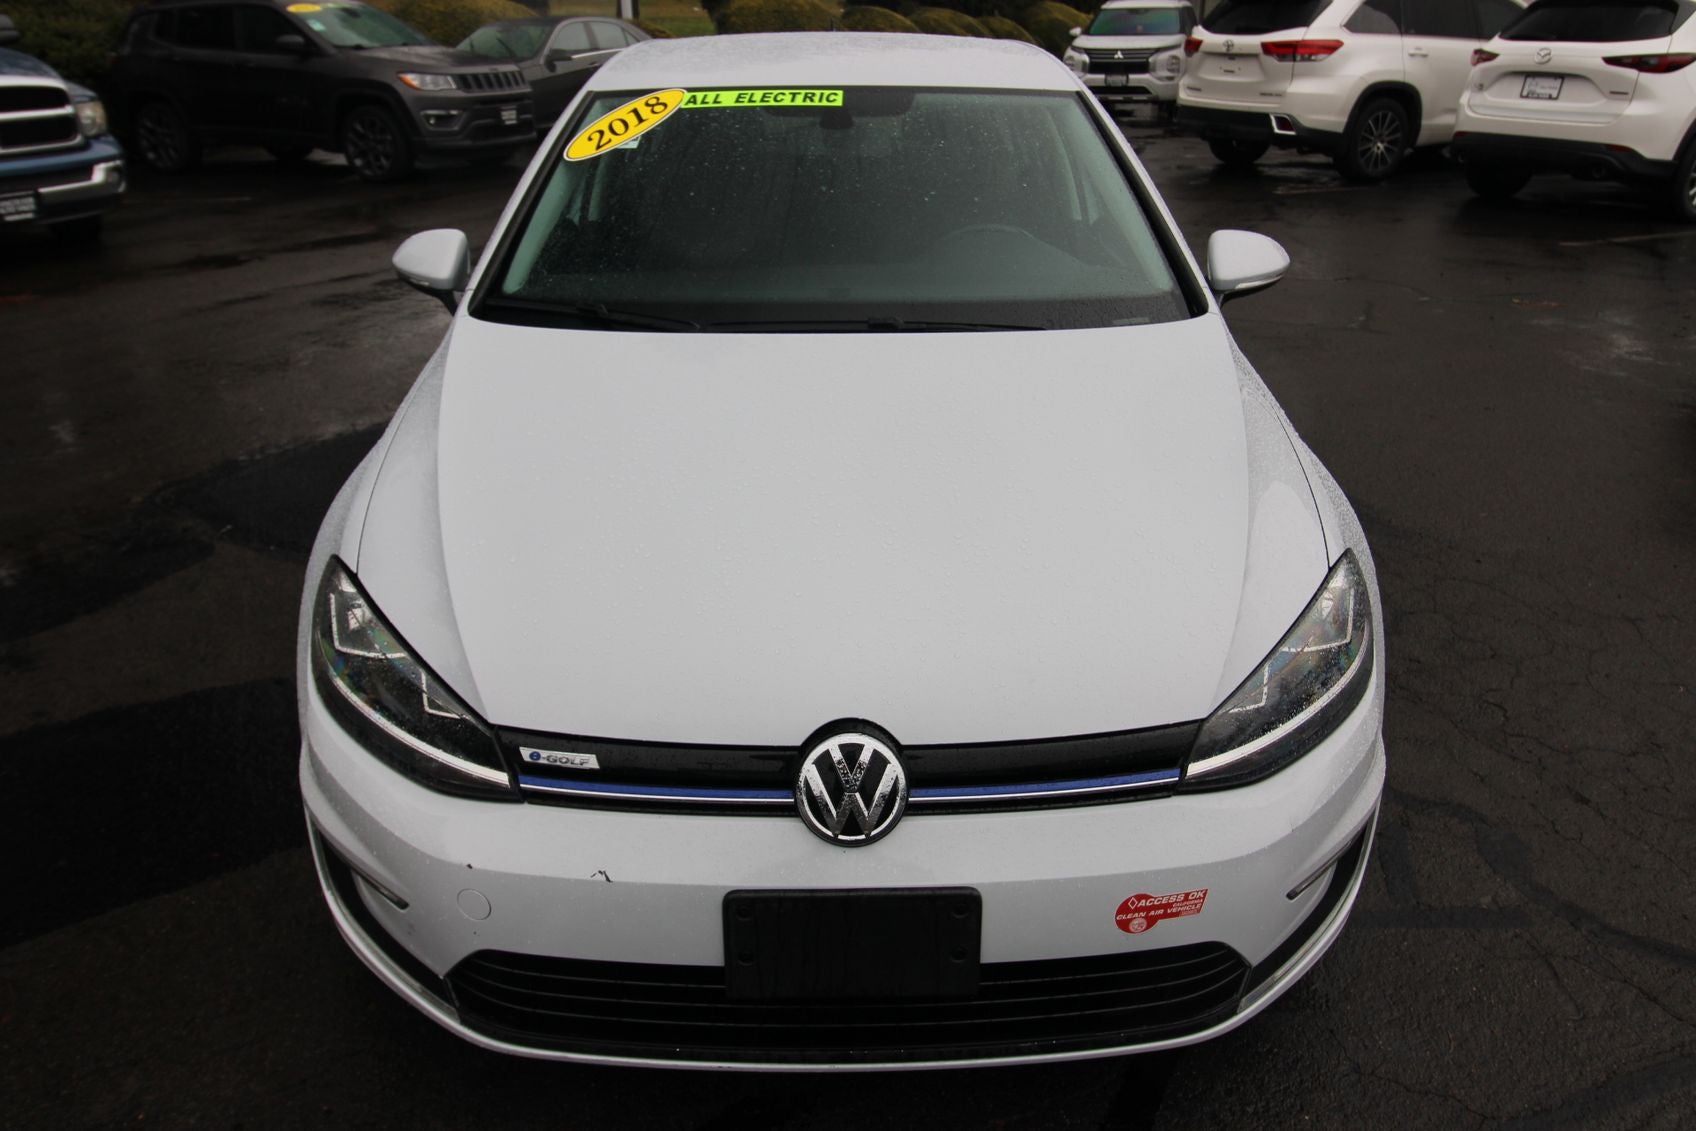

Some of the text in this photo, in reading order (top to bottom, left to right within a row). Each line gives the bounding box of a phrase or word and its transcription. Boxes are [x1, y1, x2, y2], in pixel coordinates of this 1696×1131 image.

[684, 92, 839, 106] ALL ELECTRIC
[587, 95, 668, 151] 2018
[1137, 890, 1206, 907] ACCESS OK
[1116, 912, 1146, 920] CLEAN
[1148, 909, 1164, 917] AIR
[1167, 903, 1202, 914] VEHICLE
